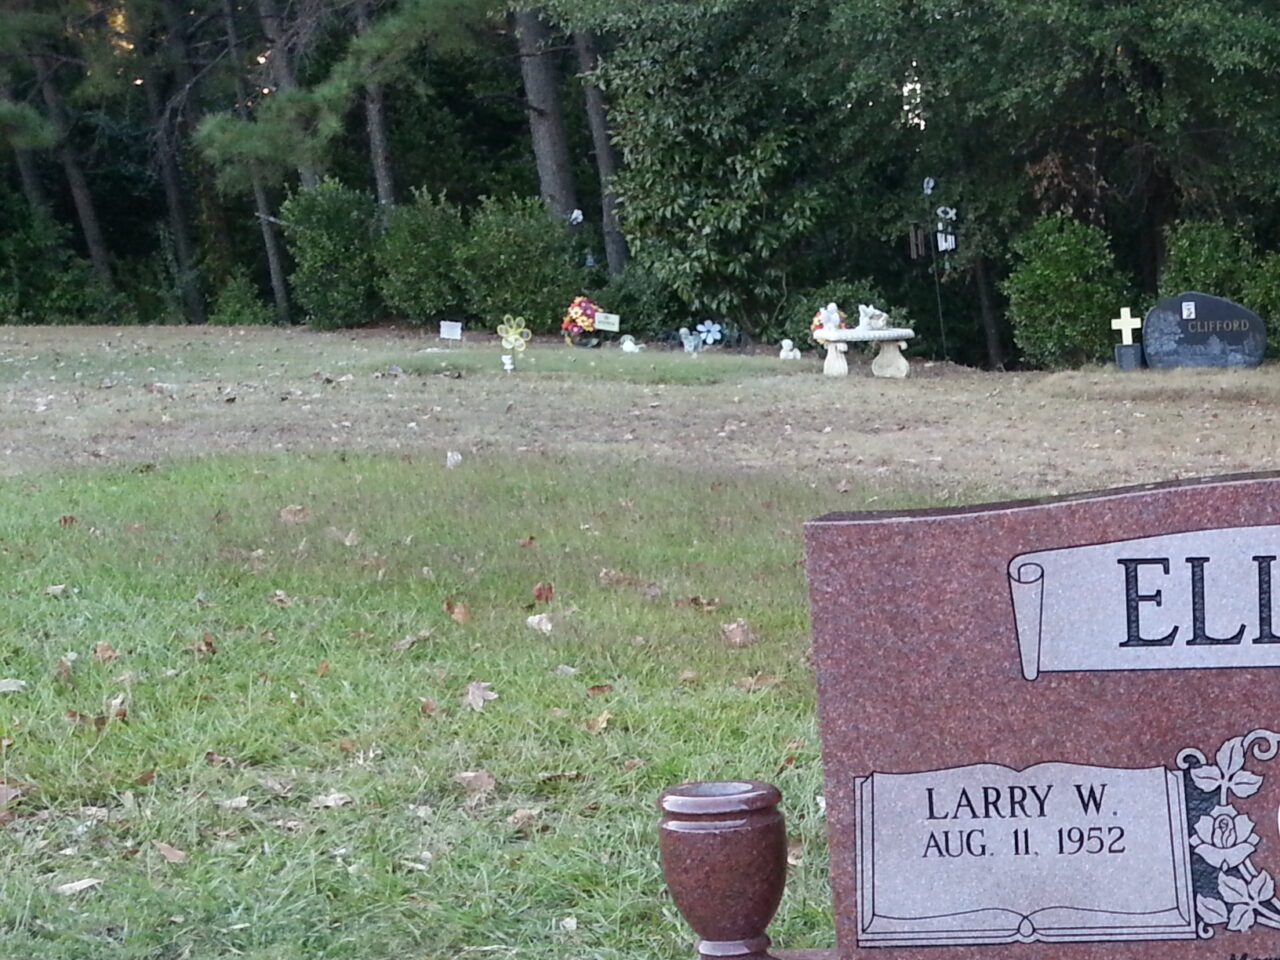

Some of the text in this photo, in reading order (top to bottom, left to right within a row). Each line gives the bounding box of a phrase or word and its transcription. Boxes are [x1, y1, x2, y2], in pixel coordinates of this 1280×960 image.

[1188, 320, 1249, 332] CLIFFORD
[925, 783, 1118, 820] LARRY W.
[922, 826, 1126, 858] AUG. 11, 1952
